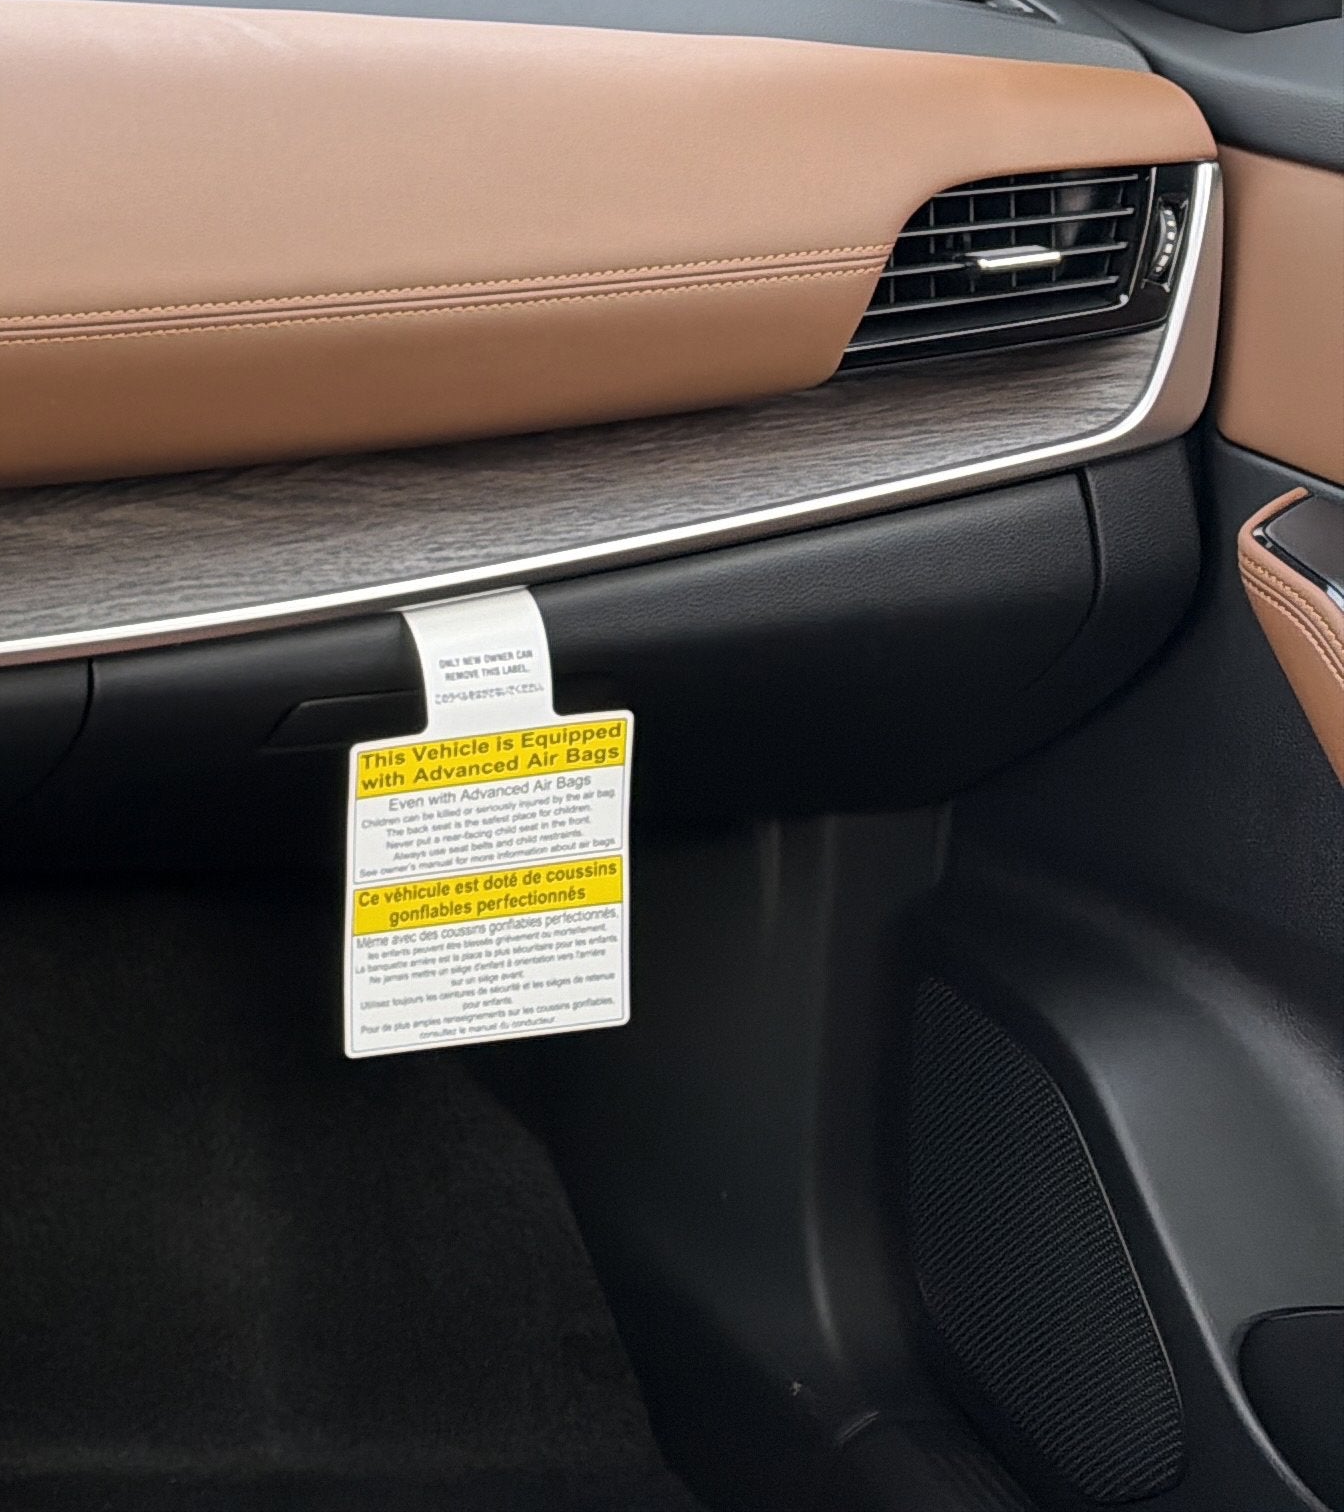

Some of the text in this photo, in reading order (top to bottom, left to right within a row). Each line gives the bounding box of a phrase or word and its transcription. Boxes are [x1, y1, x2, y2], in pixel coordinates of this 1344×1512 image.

[361, 722, 621, 769] This Vehicle is Equipped
[361, 746, 619, 790] with Advanced Air Bags
[388, 775, 591, 811] Even with Advanced Air Bags
[358, 862, 616, 907] Ce véhicule est doté de coussins
[388, 885, 585, 927] gonflables perfectionnés
